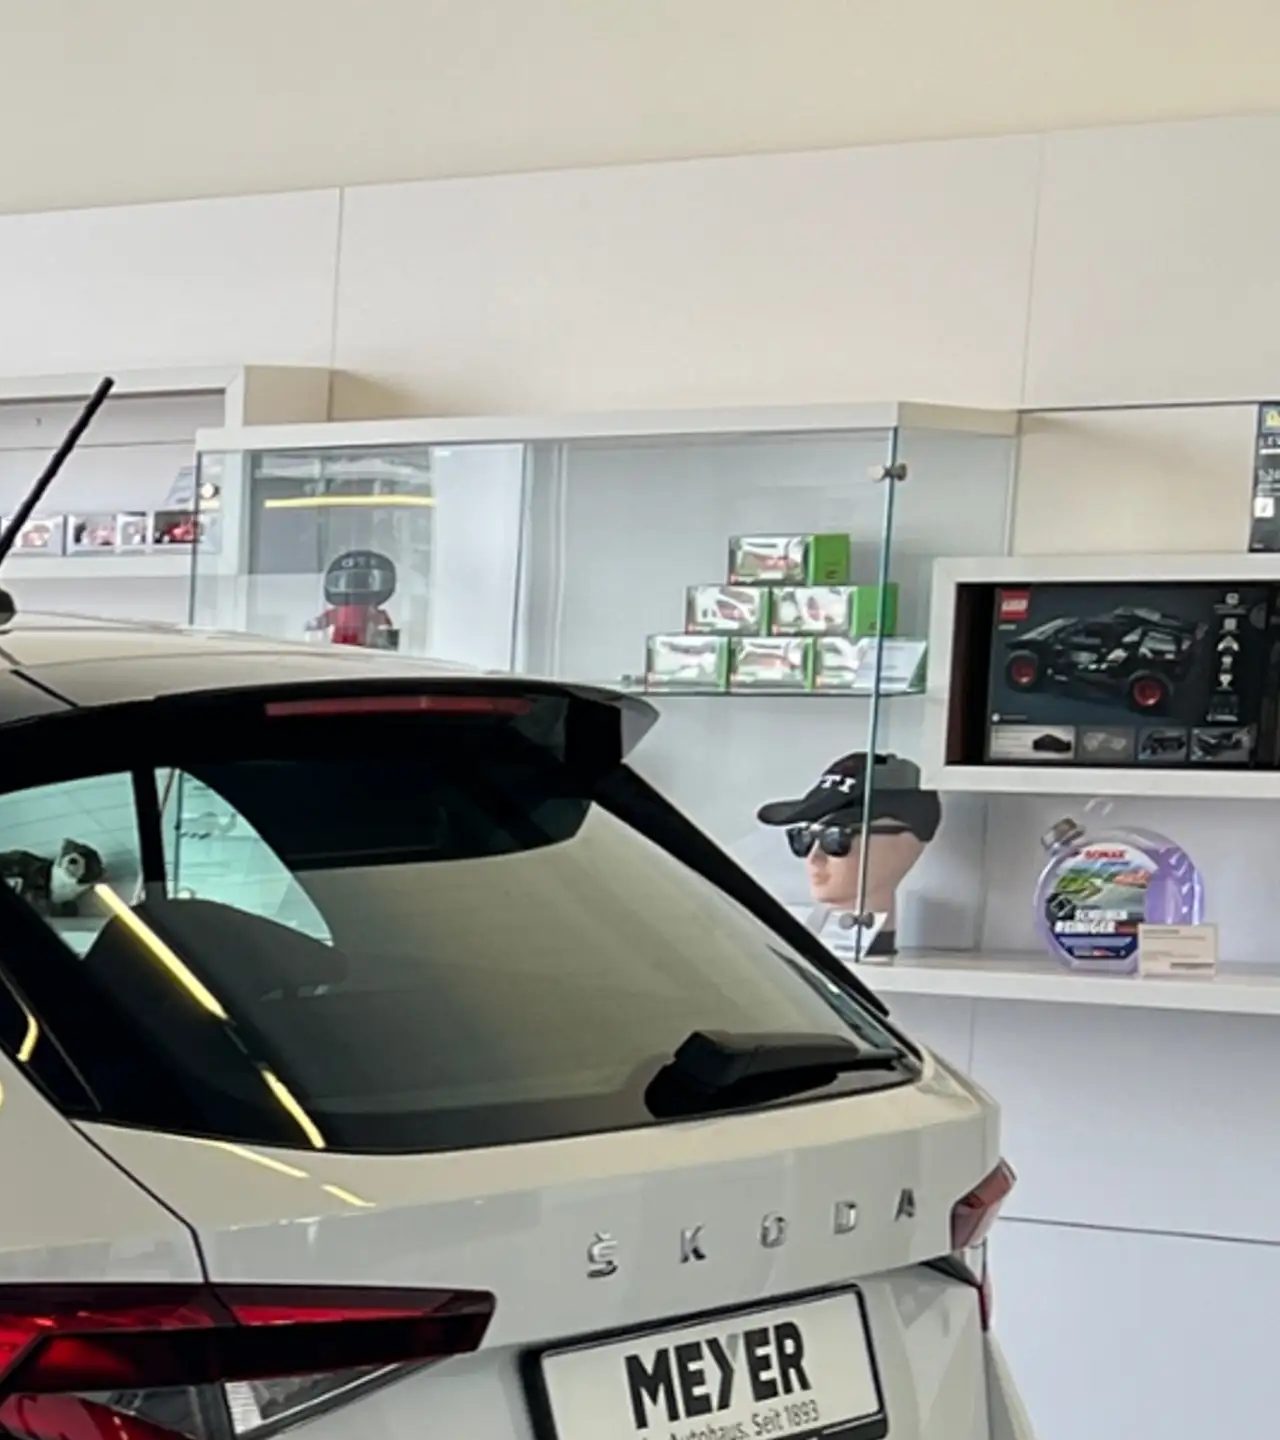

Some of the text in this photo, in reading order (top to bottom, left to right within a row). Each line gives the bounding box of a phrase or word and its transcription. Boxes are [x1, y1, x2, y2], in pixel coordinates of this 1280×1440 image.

[625, 1321, 812, 1430] MEYER
[751, 1408, 782, 1436] Seit
[784, 1400, 820, 1427] 1893
